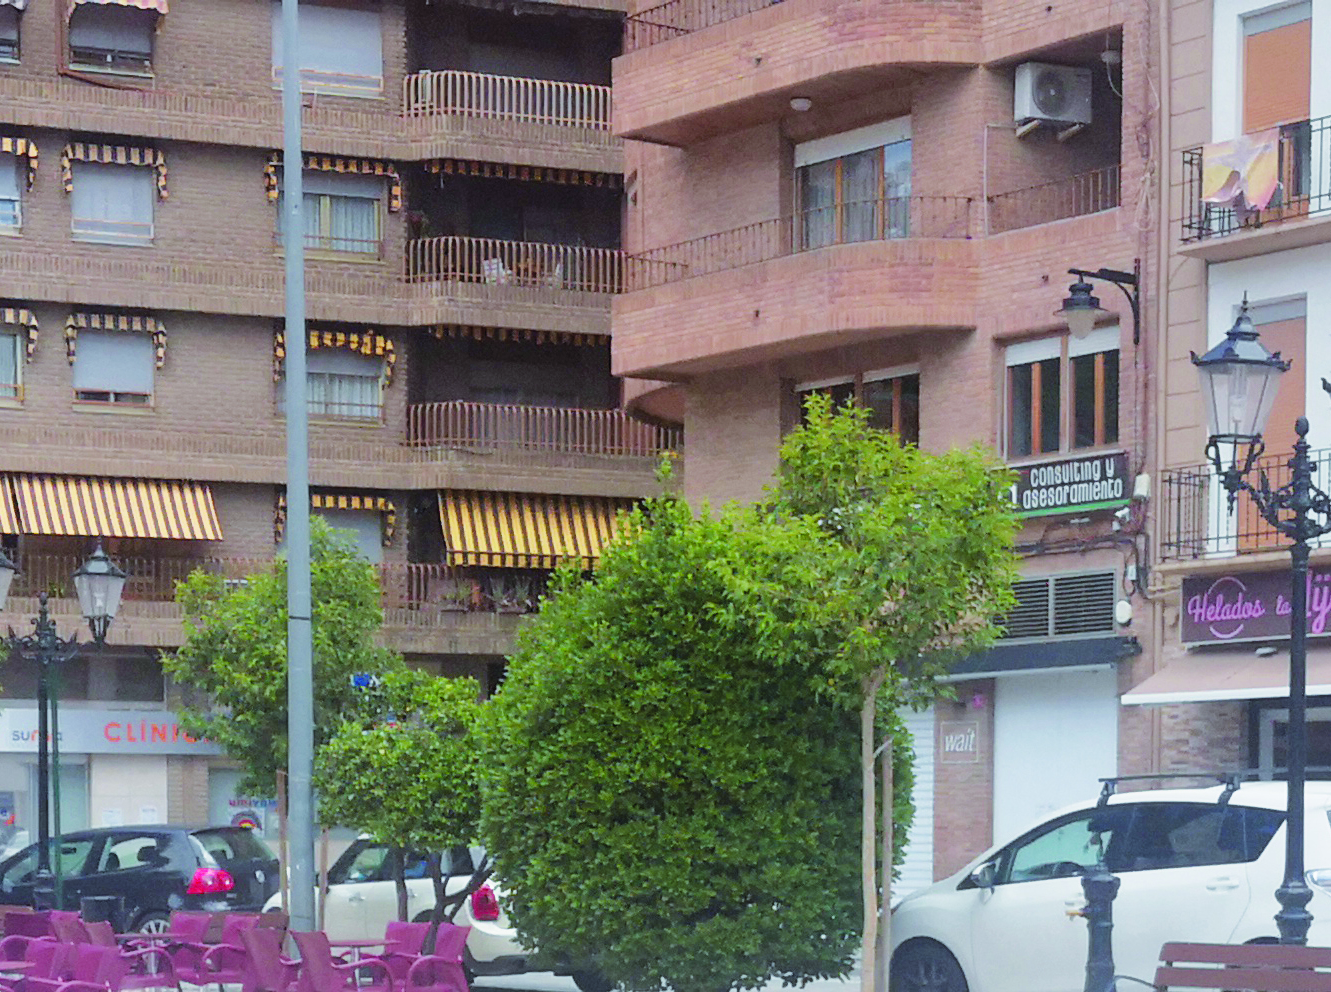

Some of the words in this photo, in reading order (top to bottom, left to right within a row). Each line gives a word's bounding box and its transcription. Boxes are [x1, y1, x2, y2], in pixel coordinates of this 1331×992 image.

[1030, 460, 1101, 488] consulting
[1022, 478, 1123, 509] asesoramiento
[1187, 592, 1266, 623] Helados
[944, 728, 976, 752] wait
